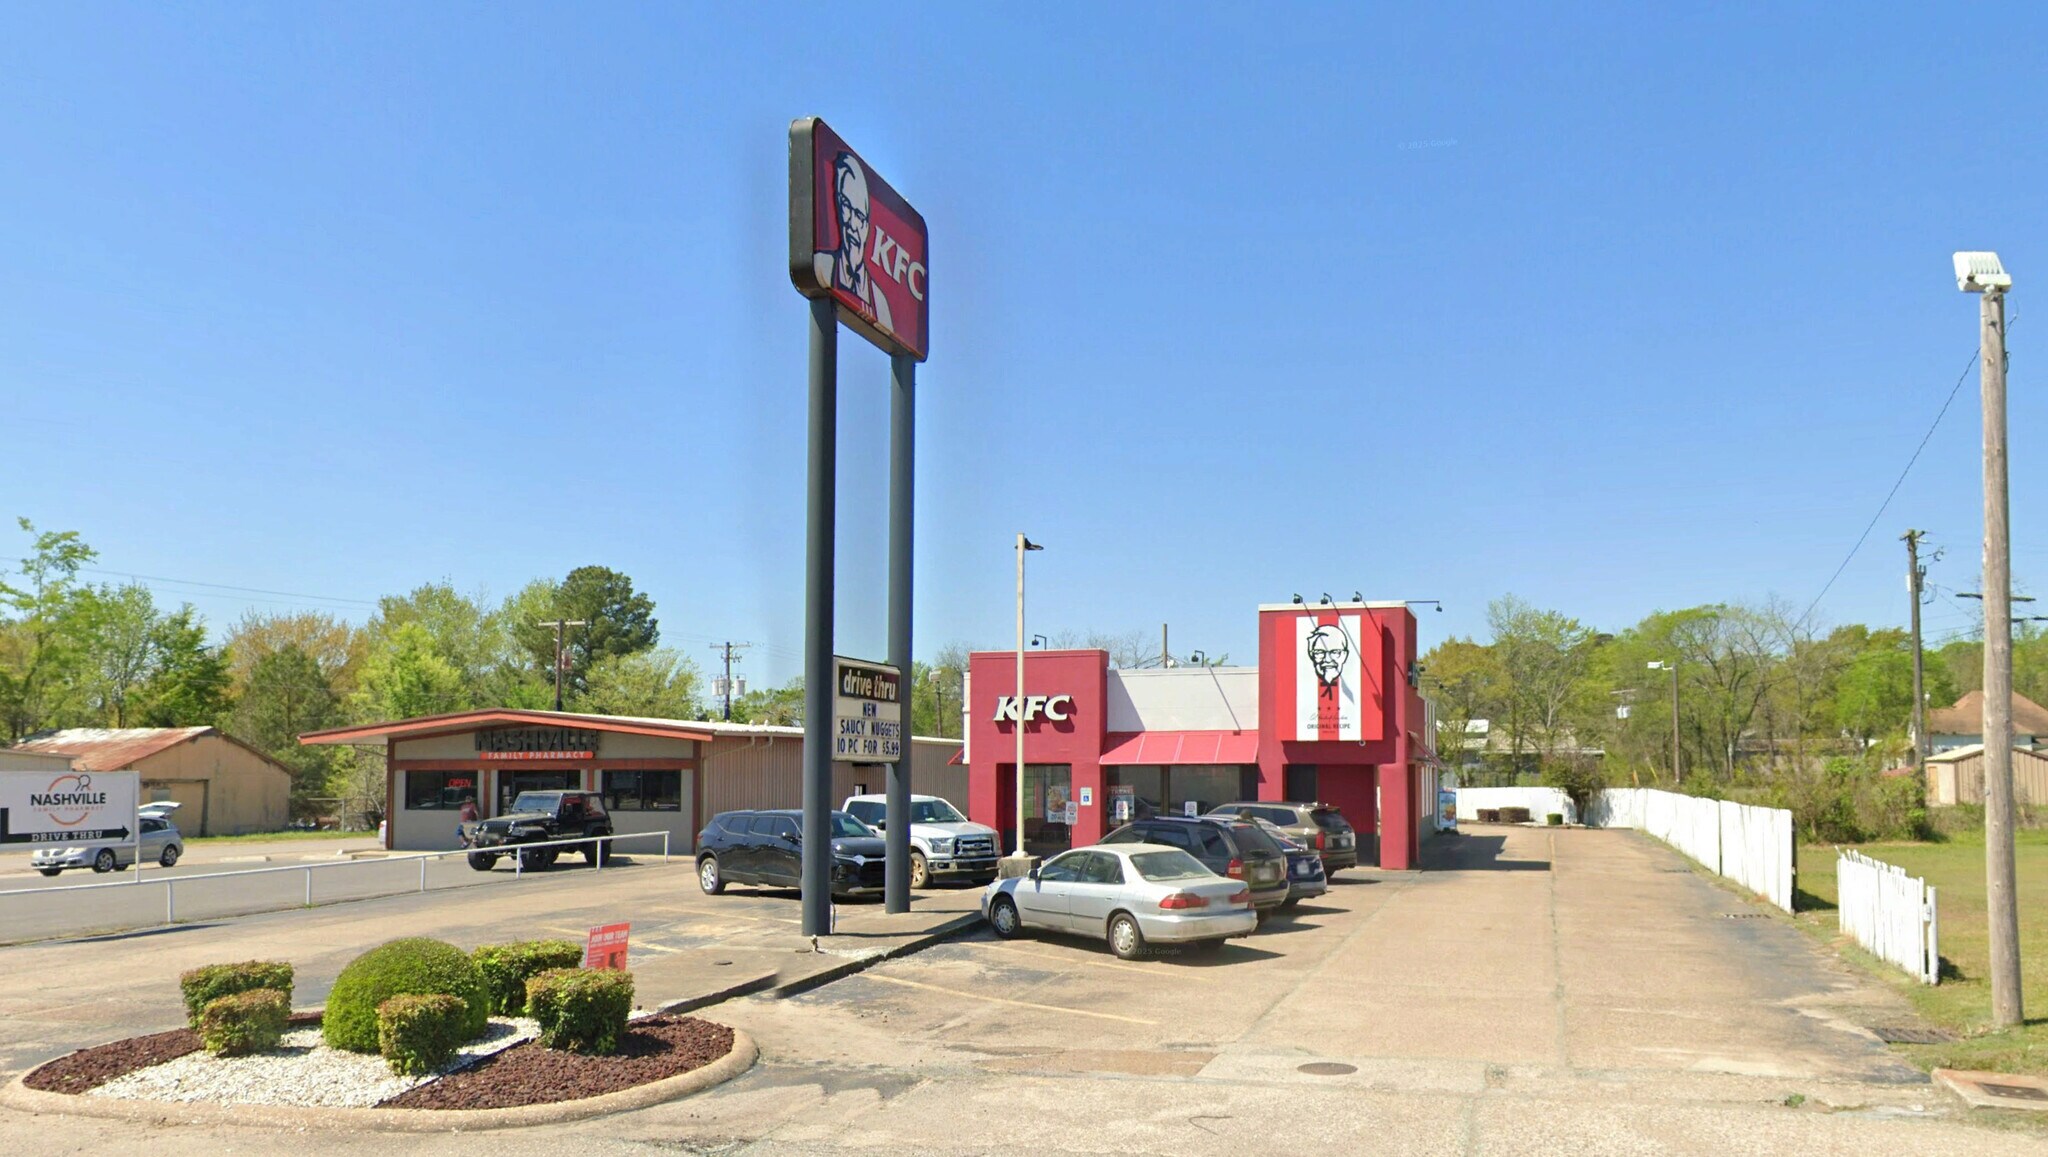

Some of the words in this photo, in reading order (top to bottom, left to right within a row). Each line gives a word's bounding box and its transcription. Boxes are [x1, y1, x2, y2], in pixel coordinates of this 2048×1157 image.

[870, 225, 927, 302] KFC
[843, 669, 872, 697] drive
[874, 675, 896, 700] thru
[862, 702, 877, 717] NEW
[993, 695, 1070, 721] KFC
[840, 719, 866, 735] SAUCY
[871, 722, 900, 737] NUGGETS
[474, 729, 600, 751] NASHVILLE
[837, 738, 846, 753] 10
[848, 739, 858, 753] PC
[863, 740, 878, 754] FOR
[882, 740, 900, 756] $5.99
[487, 751, 524, 760] FAMILY
[528, 751, 586, 760] PHARMACY
[448, 778, 472, 788] OPEN
[30, 792, 106, 806] NASHVILLE
[31, 832, 69, 842] DRIVE
[71, 830, 103, 840] THRU
[614, 929, 629, 940] TEAM
